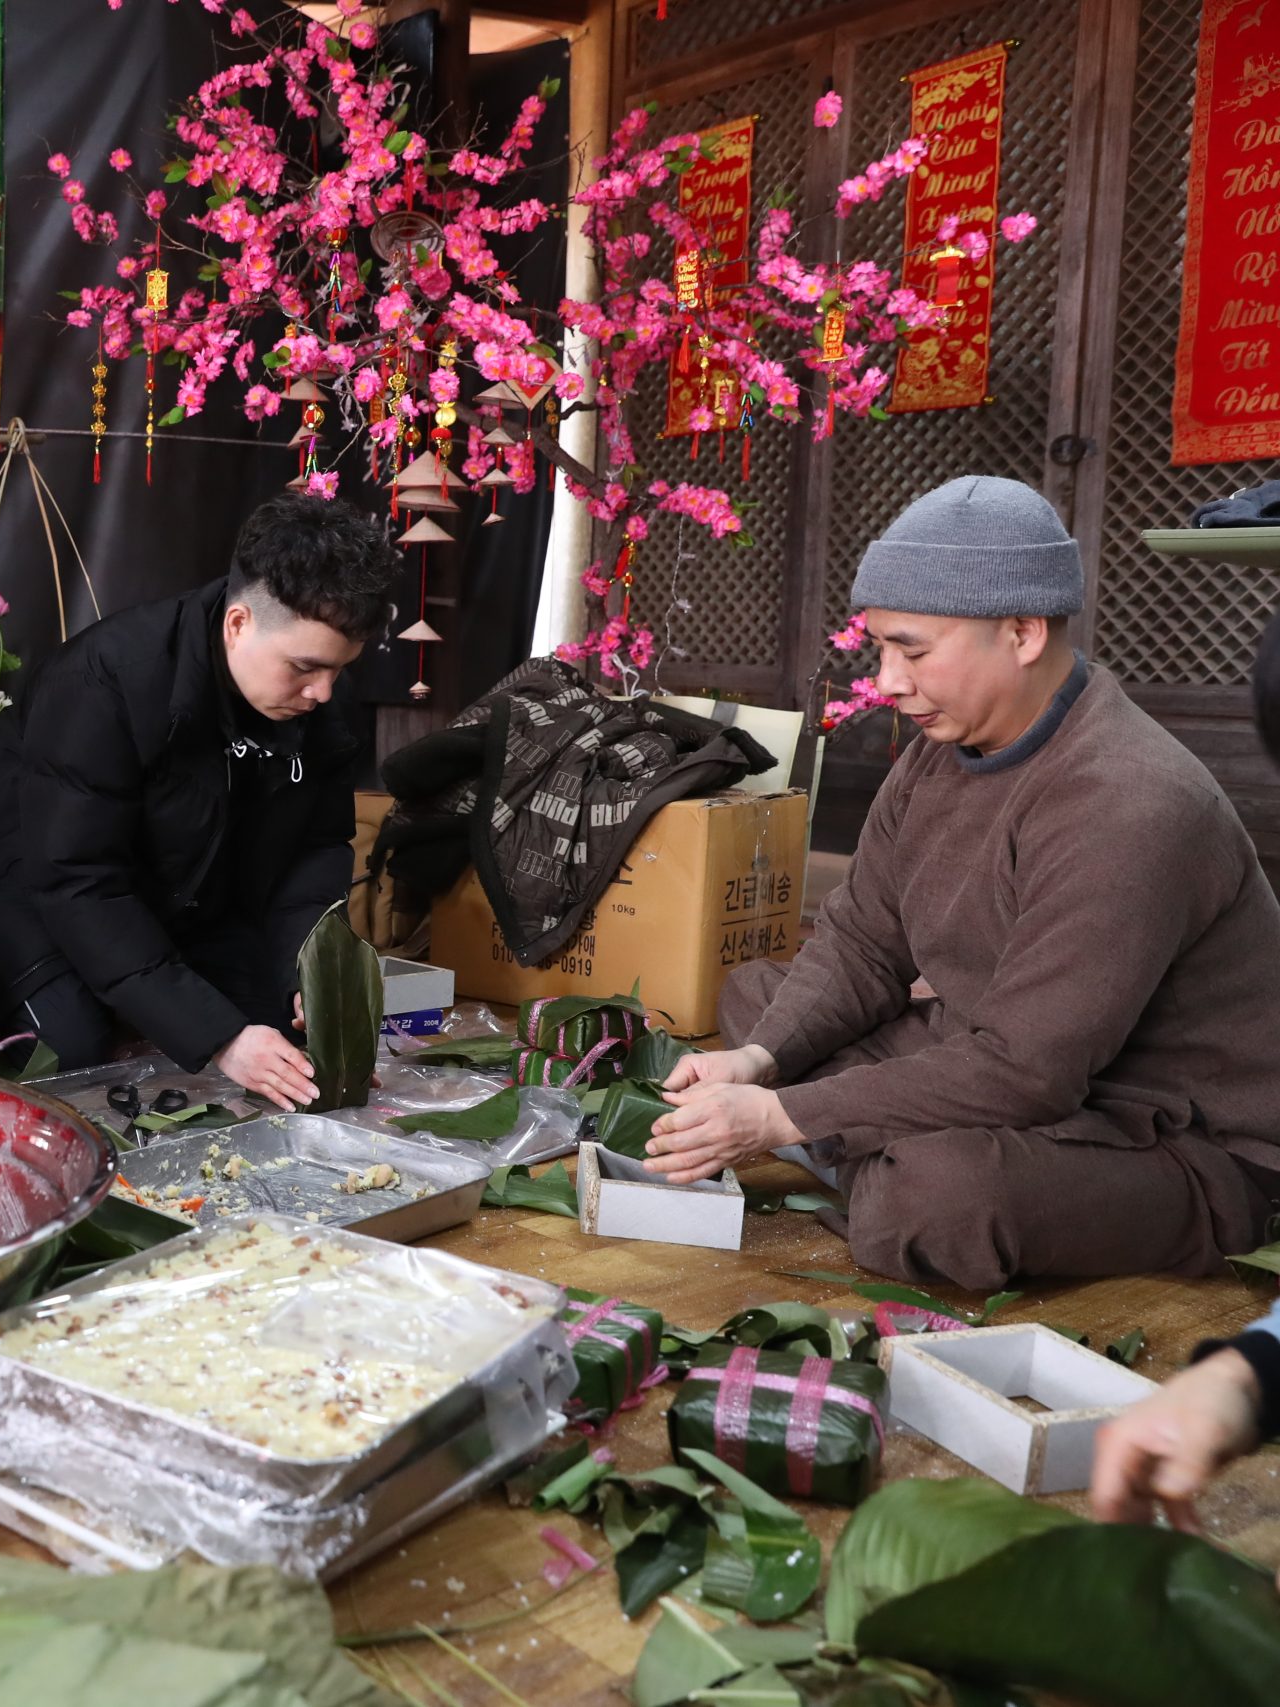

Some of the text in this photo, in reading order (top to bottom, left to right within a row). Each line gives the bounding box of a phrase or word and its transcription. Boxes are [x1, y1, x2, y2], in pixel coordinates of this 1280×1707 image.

[1233, 251, 1278, 287] Rộ
[1209, 298, 1280, 332] Mừn
[1220, 338, 1271, 373] Tết
[1214, 382, 1280, 416] Đến
[724, 870, 792, 912] 긴급배송
[611, 904, 636, 916] 10kg
[719, 923, 787, 966] 신선채소
